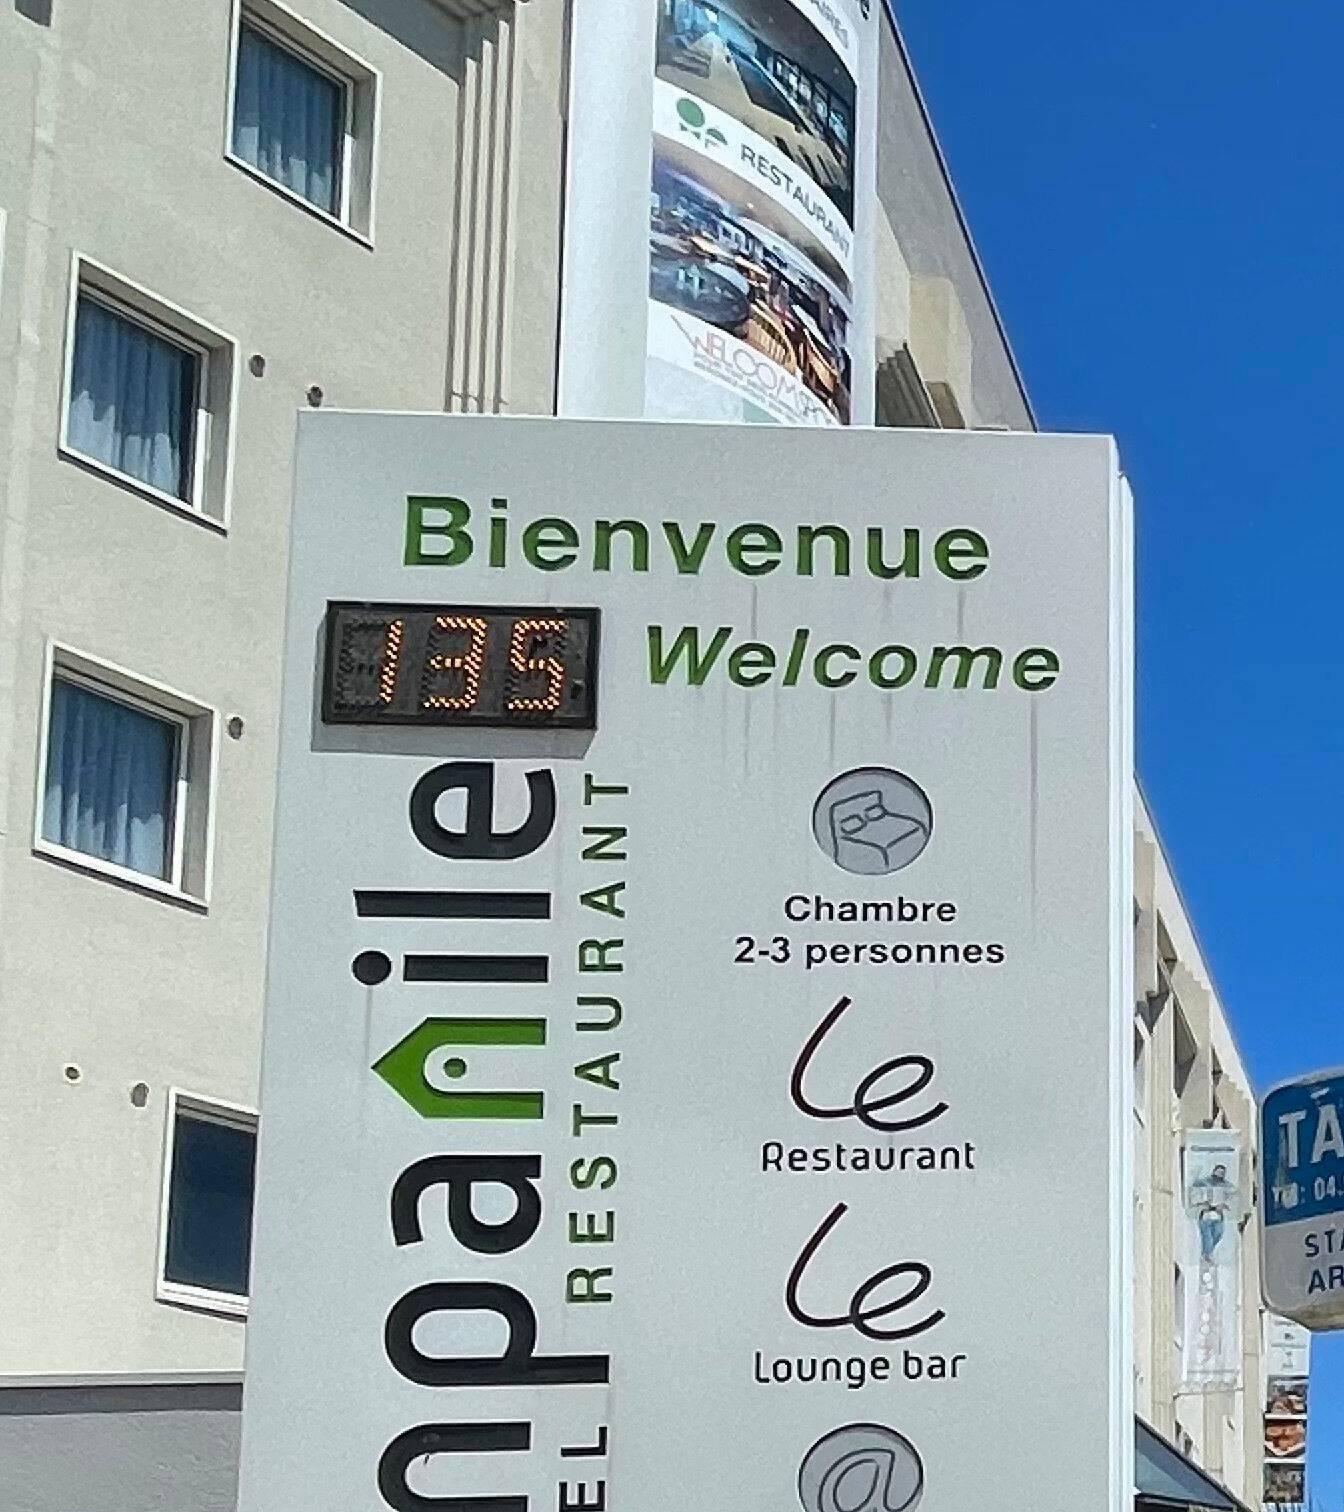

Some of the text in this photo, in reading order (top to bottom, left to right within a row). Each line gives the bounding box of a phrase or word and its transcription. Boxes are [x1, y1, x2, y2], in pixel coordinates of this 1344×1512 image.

[403, 494, 990, 580] Bienvenue
[378, 616, 569, 709] 135
[646, 624, 1061, 692] Welcome
[784, 894, 957, 923] Chambre
[734, 936, 1005, 970] 2-3 personnes
[566, 772, 630, 1304] RESTAURANT
[761, 1140, 976, 1172] Restaurant
[754, 1350, 967, 1390] Lounge bar
